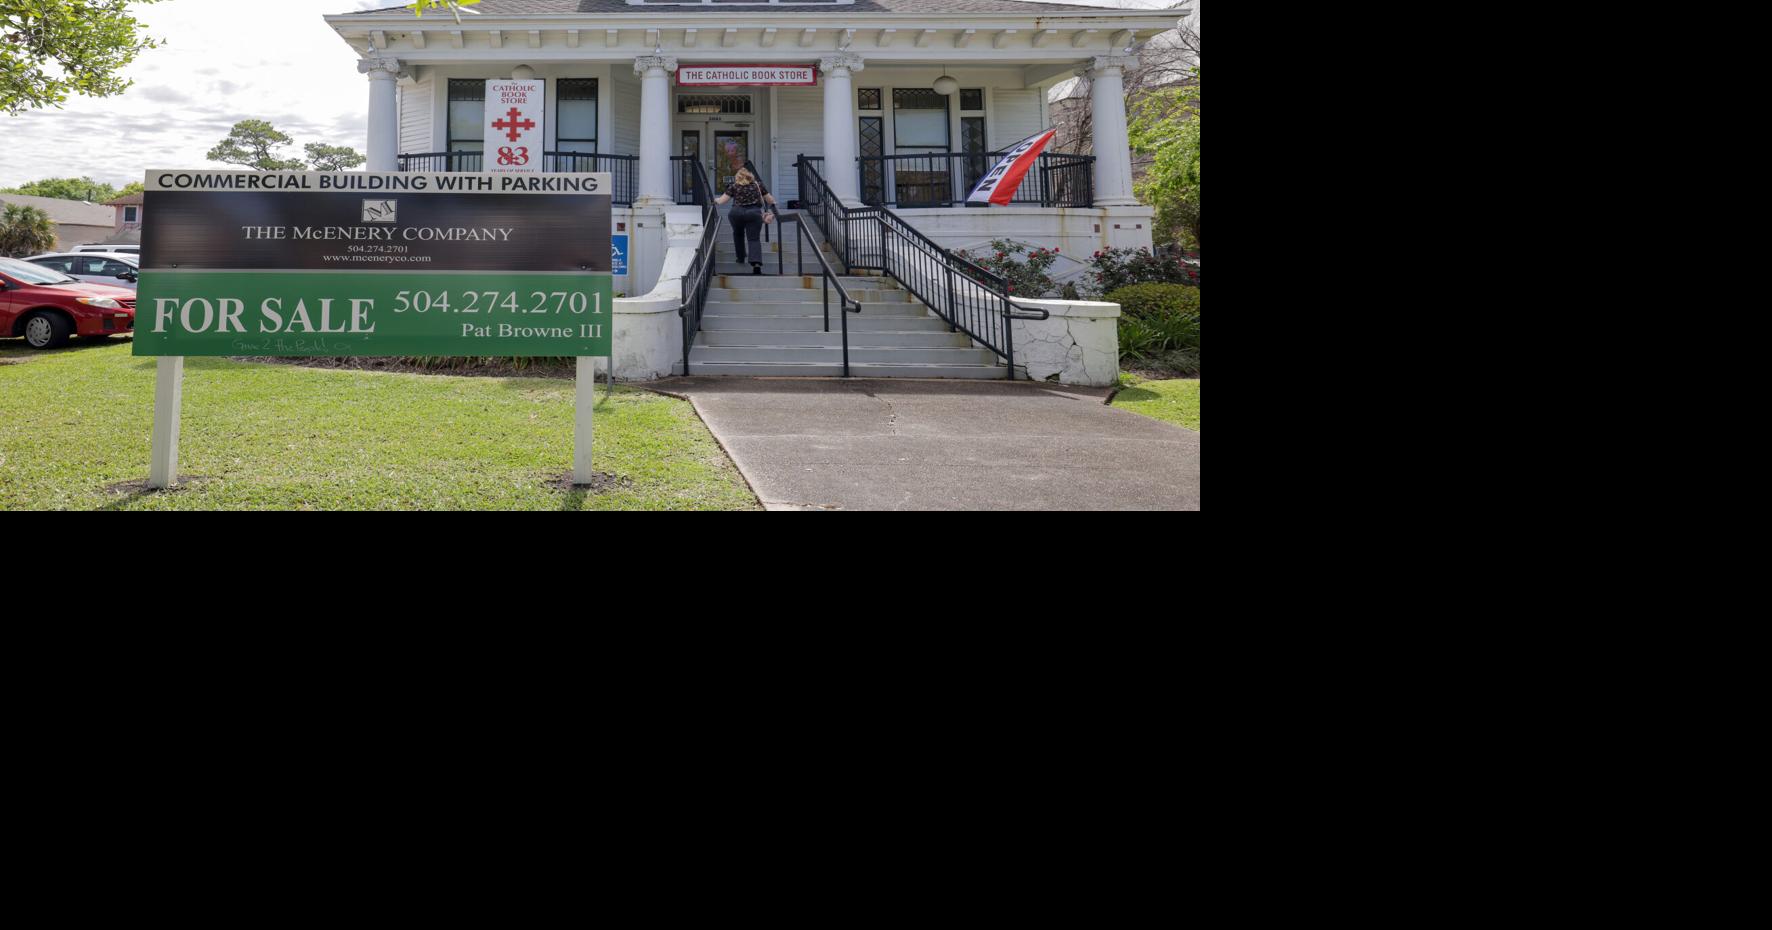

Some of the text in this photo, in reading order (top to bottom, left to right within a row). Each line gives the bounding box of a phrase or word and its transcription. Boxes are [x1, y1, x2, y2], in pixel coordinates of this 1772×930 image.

[686, 70, 808, 81] THE CATHOLIC BOOK STORE
[976, 140, 1034, 192] OPEN
[157, 173, 598, 192] COMMERCIAL BUILDING WITH PARKING
[242, 226, 514, 241] THE McENERY COMPANY
[347, 245, 409, 254] 504.274.2701
[323, 254, 431, 264] www.mceneryco.com
[393, 290, 603, 315] 504.274.2701
[151, 297, 376, 334] FOR SALE
[462, 323, 602, 338] Pat Browne III
